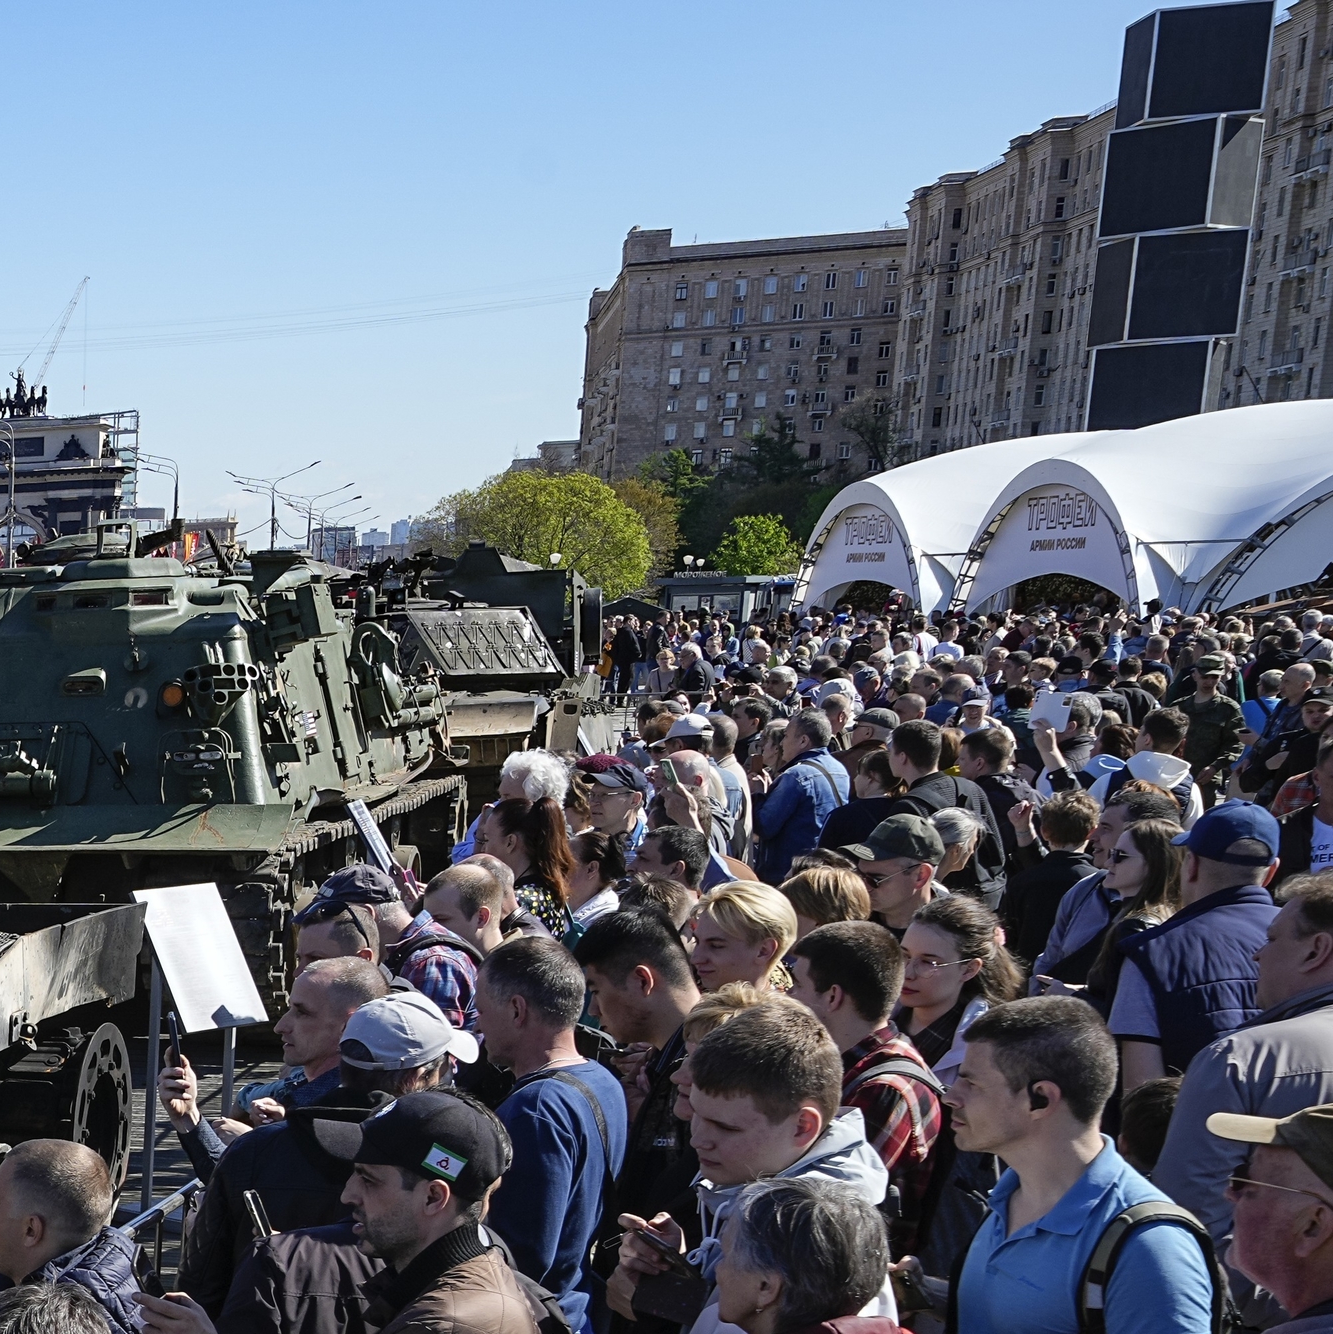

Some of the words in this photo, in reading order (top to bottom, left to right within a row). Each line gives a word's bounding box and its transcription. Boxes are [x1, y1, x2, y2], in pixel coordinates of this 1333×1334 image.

[1027, 493, 1097, 531] ТРОФЕИ
[1029, 538, 1055, 552] АРМИИ
[1056, 536, 1087, 550] РОССИИ
[673, 570, 728, 579] МОРОЖЕНОЕ
